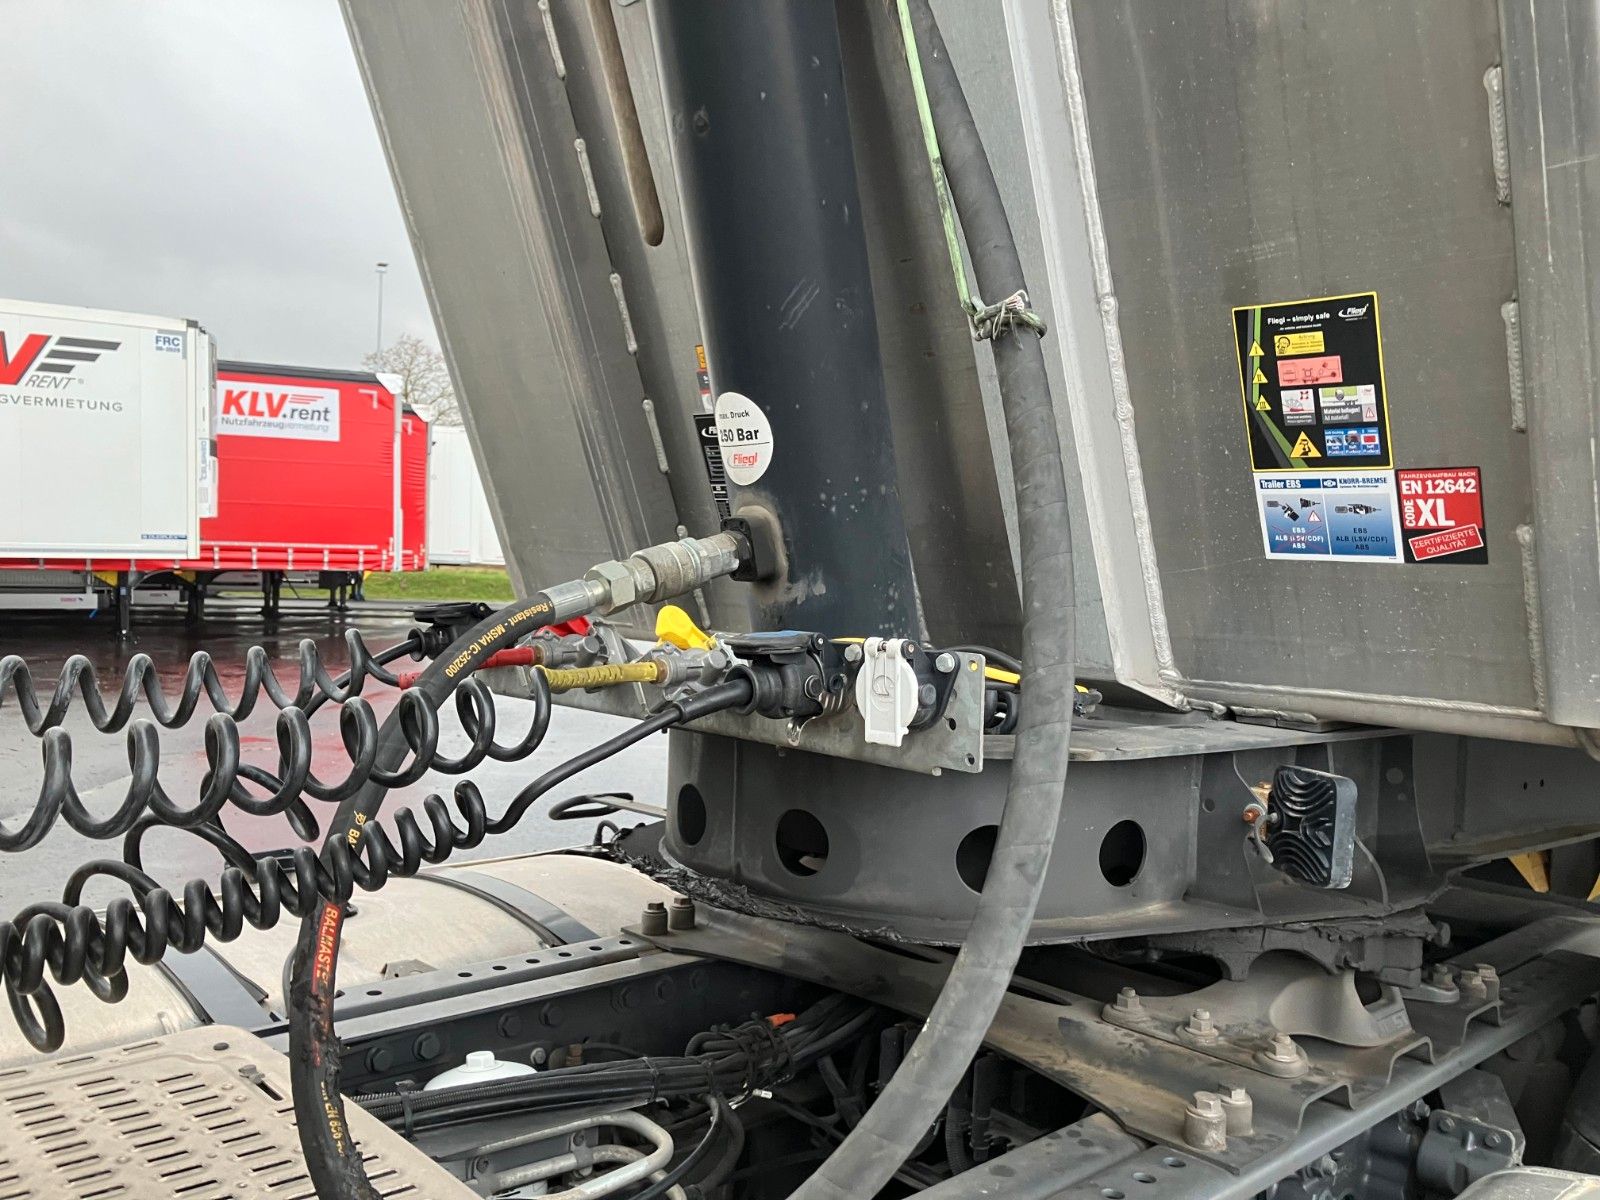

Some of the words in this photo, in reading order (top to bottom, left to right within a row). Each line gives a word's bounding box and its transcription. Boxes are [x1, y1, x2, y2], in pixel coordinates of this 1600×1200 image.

[1267, 316, 1286, 326] Fliegl
[1292, 314, 1314, 323] simply
[1315, 311, 1330, 320] safe
[155, 336, 181, 347] FRC
[730, 409, 750, 419] Druck
[737, 428, 759, 442] Bar
[733, 452, 758, 467] Fliegl
[1260, 479, 1285, 489] Trailer
[1286, 479, 1302, 489] EBS
[1338, 477, 1387, 485] KNORR-BREMSE
[1401, 481, 1423, 495] EN
[1426, 478, 1476, 494] 12642
[1404, 499, 1415, 528] CODE
[1416, 498, 1456, 527] XL
[1413, 528, 1476, 549] ZERTIFIZIERTE
[1426, 539, 1468, 554] QUALITÄT
[508, 602, 549, 627] Resistant
[478, 624, 506, 646] MSHA
